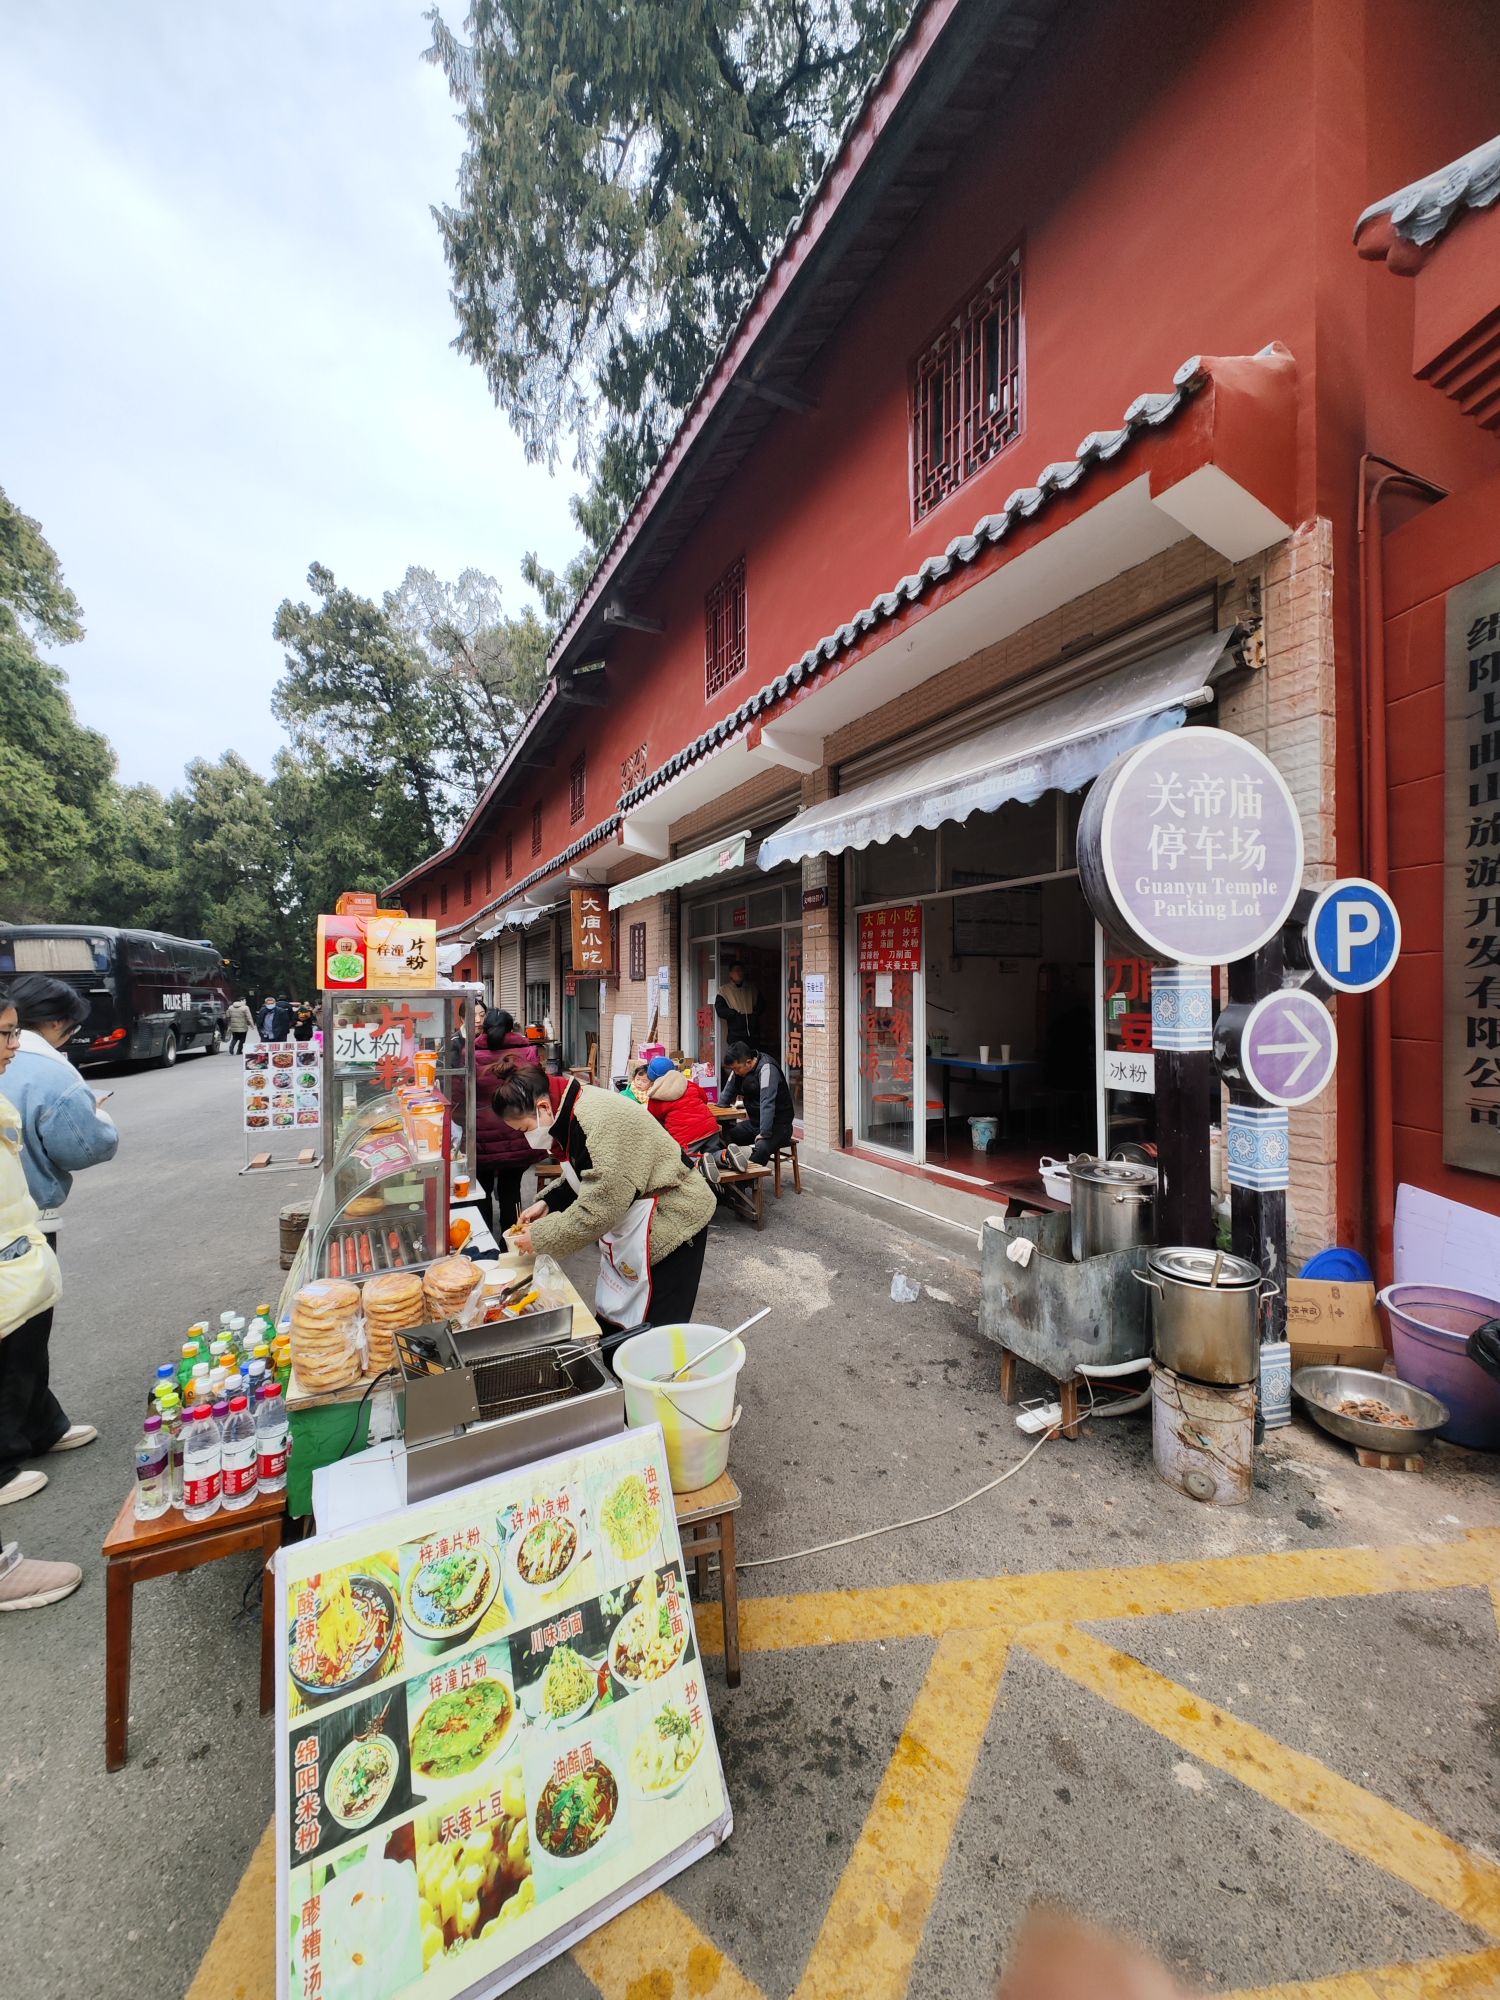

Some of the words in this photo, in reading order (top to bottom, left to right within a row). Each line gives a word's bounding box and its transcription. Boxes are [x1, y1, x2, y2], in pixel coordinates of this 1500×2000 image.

[1147, 771, 1264, 820] 关帝庙
[1147, 823, 1266, 872] 停车场
[1135, 877, 1207, 898] Guanyu
[1211, 877, 1278, 899] Temple
[865, 908, 917, 927] 大庙小吃
[1154, 900, 1227, 920] Parking
[1231, 900, 1261, 917] Lot
[580, 897, 603, 964] 大庙小吃
[902, 926, 920, 937] 抄手
[902, 938, 919, 948] 冰粉
[1336, 901, 1381, 973] P
[376, 944, 404, 957] 梓潼
[406, 936, 428, 970] 片粉
[885, 960, 918, 970] 天蚕土豆
[888, 949, 912, 959] 刀削面
[162, 993, 181, 1010] POLICE
[336, 1031, 400, 1059] 冰粉
[1110, 1062, 1147, 1083] 冰粉
[643, 1465, 660, 1506] 油茶
[511, 1494, 570, 1532] 许州凉粉
[418, 1526, 481, 1564] 梓潼片粉
[662, 1571, 684, 1637] 刀削面
[296, 1587, 318, 1676] 酸辣粉
[530, 1611, 584, 1656] 川味凉面
[429, 1655, 487, 1699] 梓潼片粉
[684, 1679, 703, 1729] 抄手
[553, 1740, 595, 1785] 油醋面
[294, 1735, 321, 1854] 绵阳米粉
[440, 1789, 506, 1846] 天蚕土豆
[301, 1893, 323, 2000] 醪糟汤
